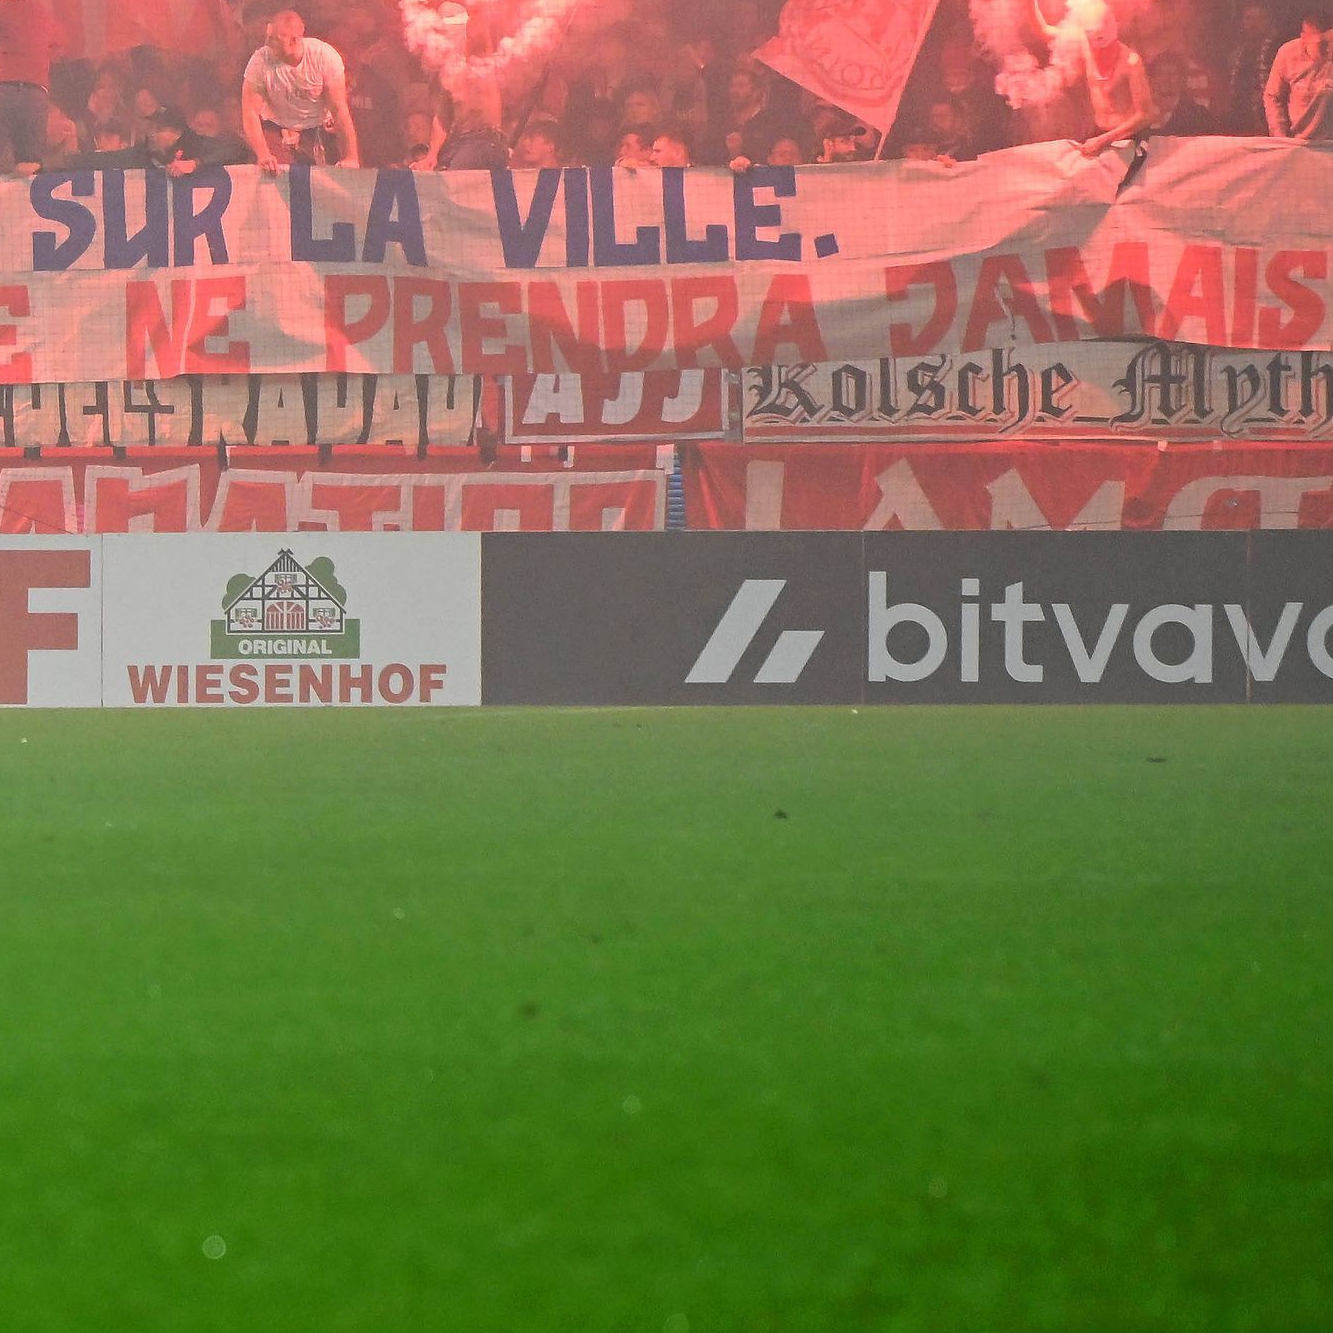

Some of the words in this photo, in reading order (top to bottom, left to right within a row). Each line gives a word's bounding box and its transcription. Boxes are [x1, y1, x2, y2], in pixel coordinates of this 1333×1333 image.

[31, 169, 230, 270] SUR
[289, 165, 427, 267] LA
[491, 165, 839, 268] VILLE.
[126, 275, 251, 380] NE
[324, 272, 828, 376] PRENDRA
[886, 241, 1332, 358] JAMAIS
[237, 638, 333, 657] ORIGINAL
[127, 664, 448, 704] WIESENHOF
